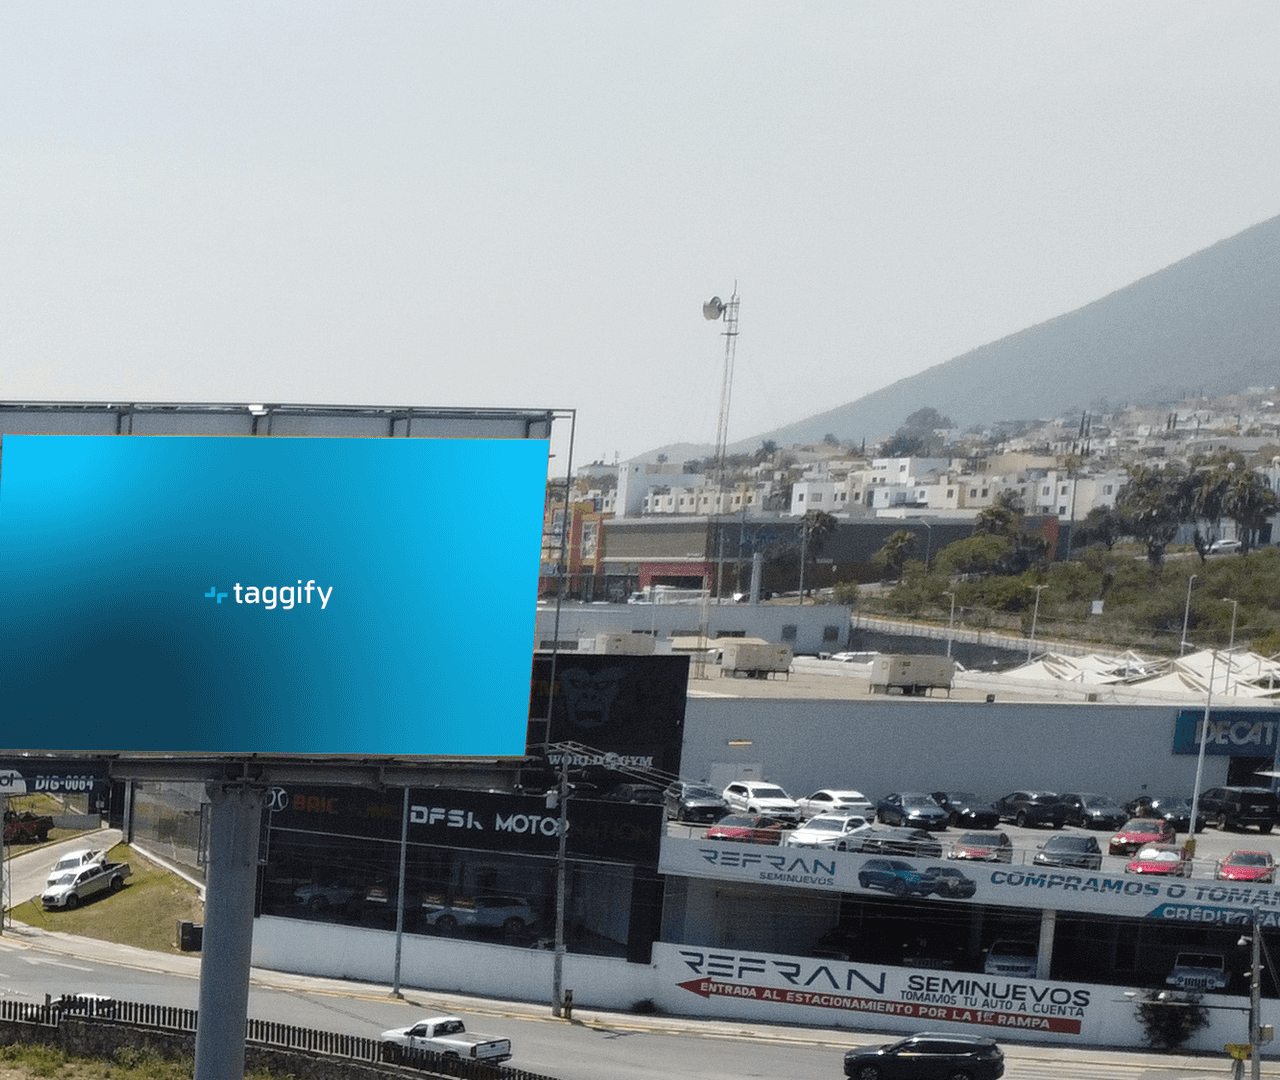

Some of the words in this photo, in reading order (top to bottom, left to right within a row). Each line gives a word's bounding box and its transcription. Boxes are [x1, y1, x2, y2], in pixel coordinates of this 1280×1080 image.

[233, 580, 333, 610] taggify
[699, 849, 837, 876] REFRAN
[759, 871, 835, 886] SEMINUEVOS
[990, 870, 1161, 897] COMPRAMOS
[1167, 883, 1187, 899] O
[679, 950, 887, 994] REFRAN
[908, 974, 1090, 1007] SEMINUEVOS
[700, 982, 757, 998] ENTRADA
[762, 990, 781, 1001] AL
[786, 992, 914, 1014] ESTACIONAMIENTO
[918, 1006, 947, 1018] POR
[952, 1010, 972, 1022] LA
[997, 1014, 1050, 1029] RAMPA
[900, 989, 957, 1005] TOMAMOS
[964, 996, 978, 1007] TU
[981, 998, 1013, 1010] AUTO
[1018, 1001, 1027, 1012] A
[1032, 1002, 1085, 1017] CUENTA
